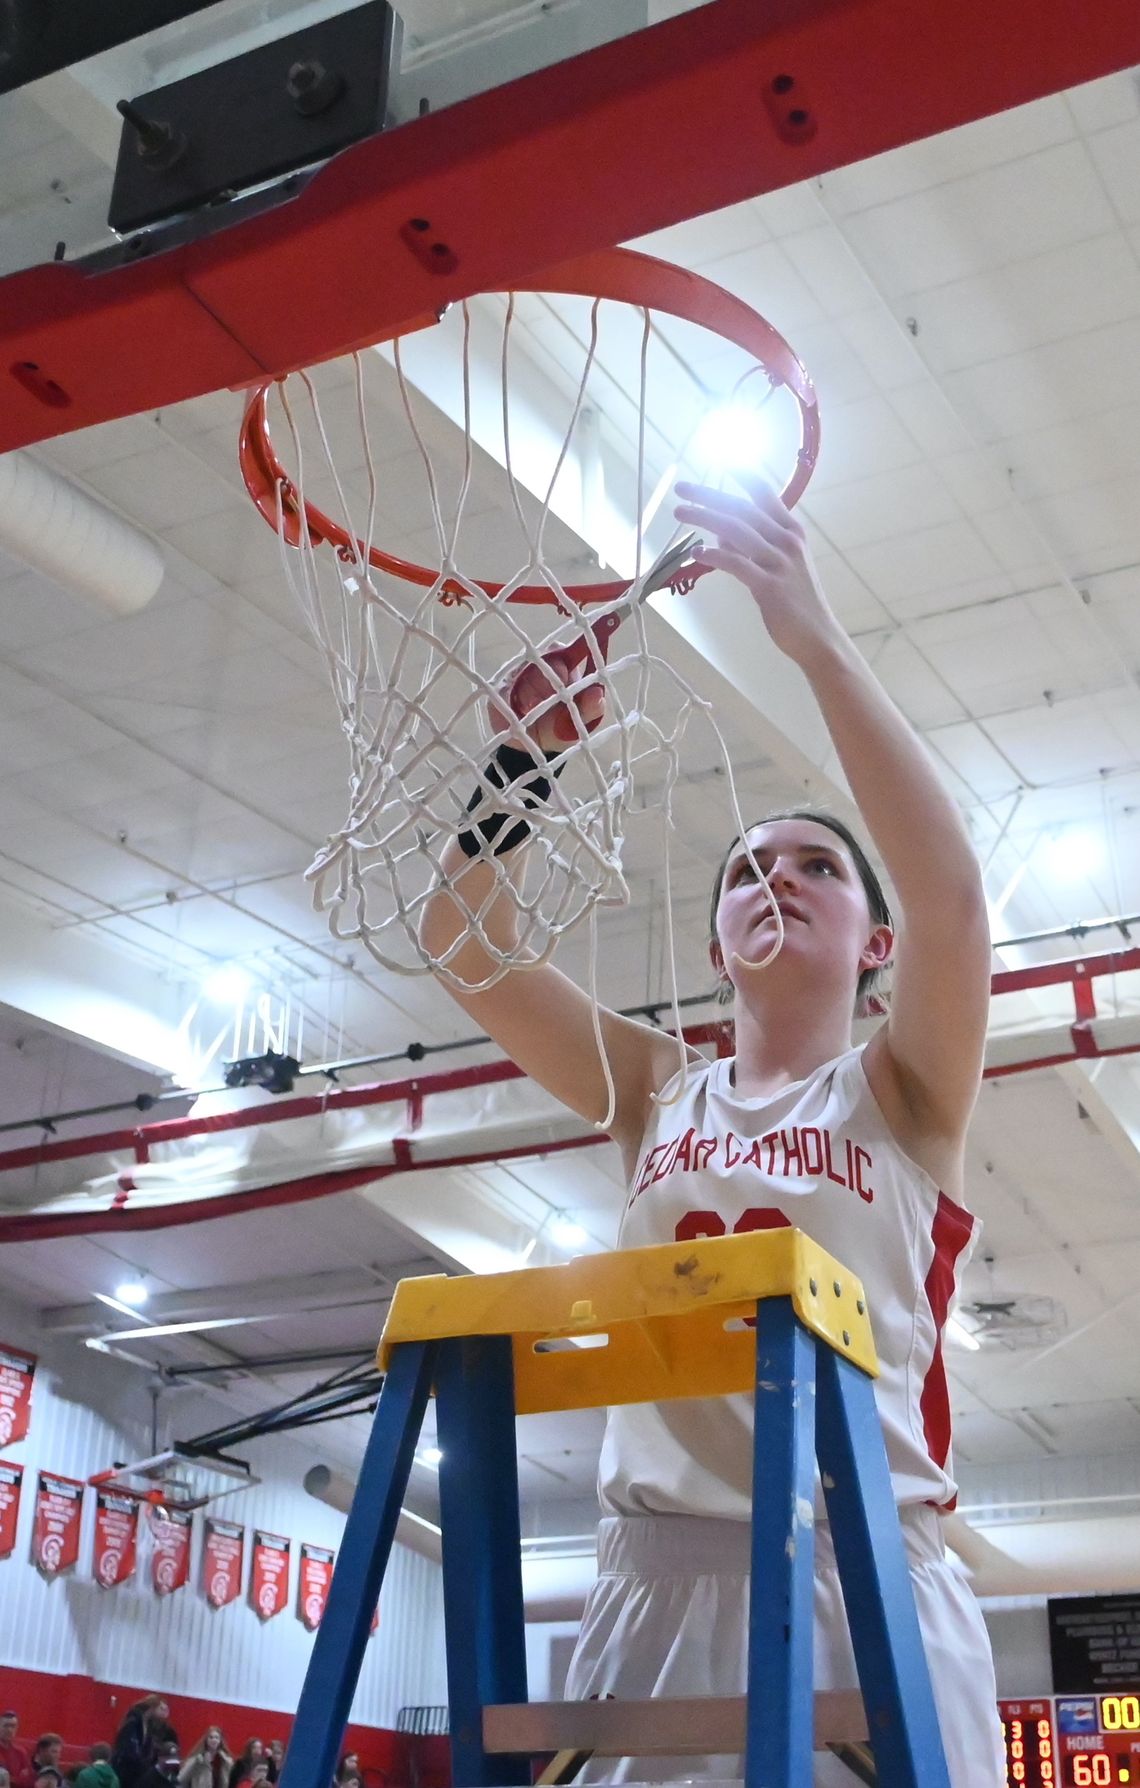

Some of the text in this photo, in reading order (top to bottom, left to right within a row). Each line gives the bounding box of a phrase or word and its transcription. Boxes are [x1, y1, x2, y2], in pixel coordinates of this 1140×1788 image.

[724, 1126, 873, 1204] CATHOLIC
[1012, 1720, 1022, 1740] 3
[1066, 1735, 1104, 1751] HOME
[1073, 1754, 1111, 1786] 60
